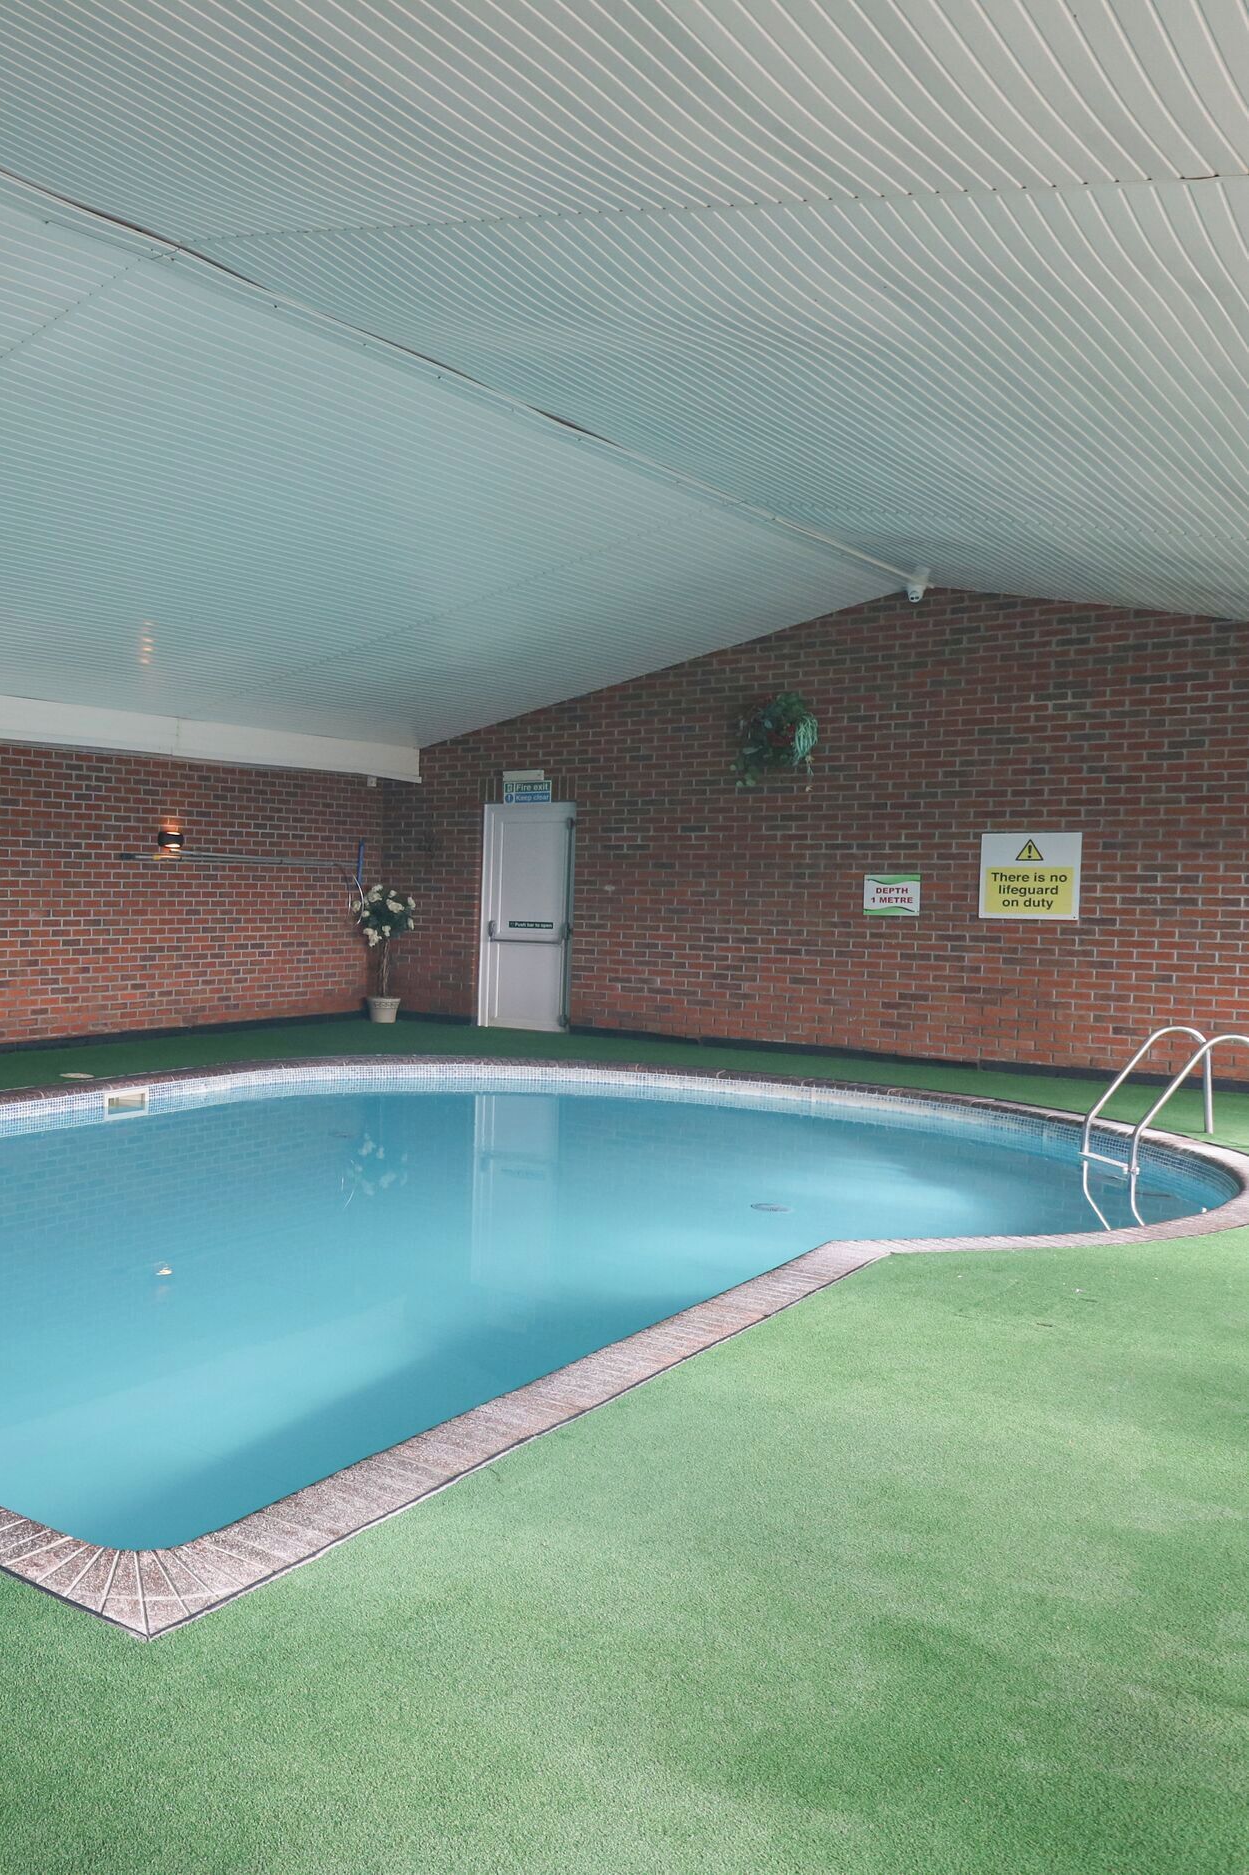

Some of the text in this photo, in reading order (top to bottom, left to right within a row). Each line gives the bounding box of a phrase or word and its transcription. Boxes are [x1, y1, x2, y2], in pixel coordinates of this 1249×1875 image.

[516, 782, 548, 791] Fire exit
[991, 872, 1068, 883] There is no
[998, 885, 1059, 897] lifeguard
[879, 896, 914, 904] METRE
[1002, 898, 1054, 910] on duty
